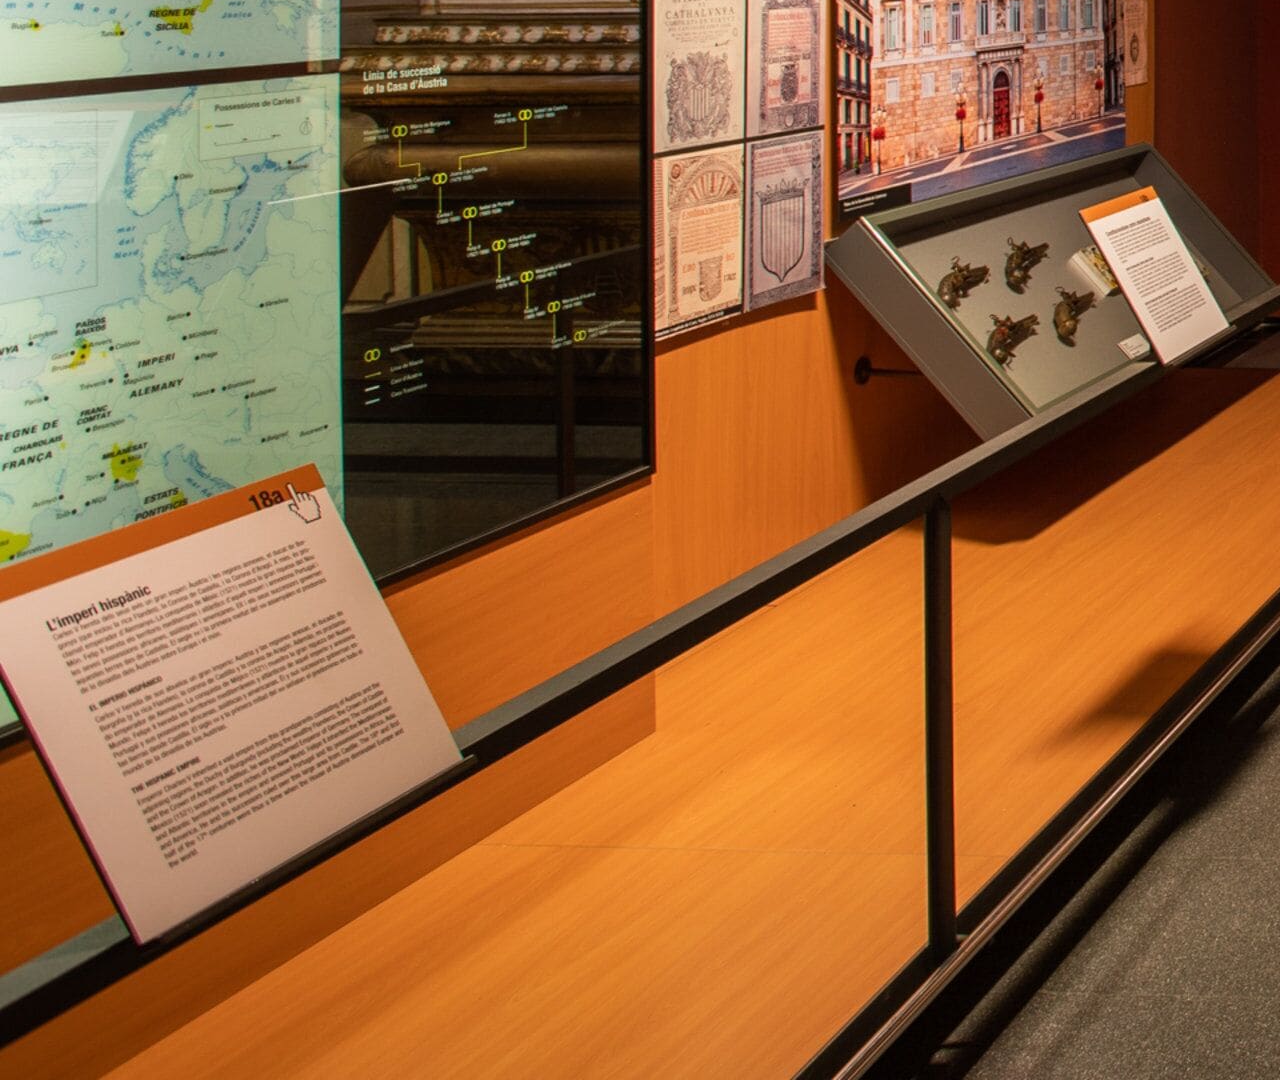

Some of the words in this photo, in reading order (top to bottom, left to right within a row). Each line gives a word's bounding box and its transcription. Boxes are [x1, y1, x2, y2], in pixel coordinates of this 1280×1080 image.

[149, 9, 180, 19] REGNE
[182, 7, 197, 17] DE
[155, 21, 190, 32] SICÍLIA
[387, 69, 398, 79] de
[399, 65, 441, 78] successió
[363, 85, 374, 95] de
[376, 83, 385, 94] la
[386, 81, 408, 93] Casa
[410, 77, 448, 90] d'Àustria
[214, 101, 260, 112] Possessions
[262, 99, 271, 107] de
[272, 98, 294, 106] Carles
[113, 249, 140, 259] Nord
[75, 316, 106, 329] PAÏSOS
[28, 329, 58, 340] Londres
[75, 324, 106, 337] BAIXOS
[137, 352, 176, 368] IMPERI
[129, 377, 184, 399] ALEMANY
[80, 404, 108, 417] FRANC
[42, 419, 60, 431] DE
[76, 411, 112, 426] COMTAT
[13, 434, 63, 454] CHAROLAIS
[102, 442, 148, 460] MILANESAT
[2, 451, 53, 471] FRANÇA
[143, 487, 179, 505] ESTATS
[248, 490, 284, 511] 18a
[45, 603, 98, 632] L'imperi
[99, 585, 152, 612] hispànic
[98, 691, 127, 708] IMPERIO
[130, 782, 145, 795] THE
[144, 767, 177, 788] HISPANIC
[175, 755, 201, 773] EMPIRE
